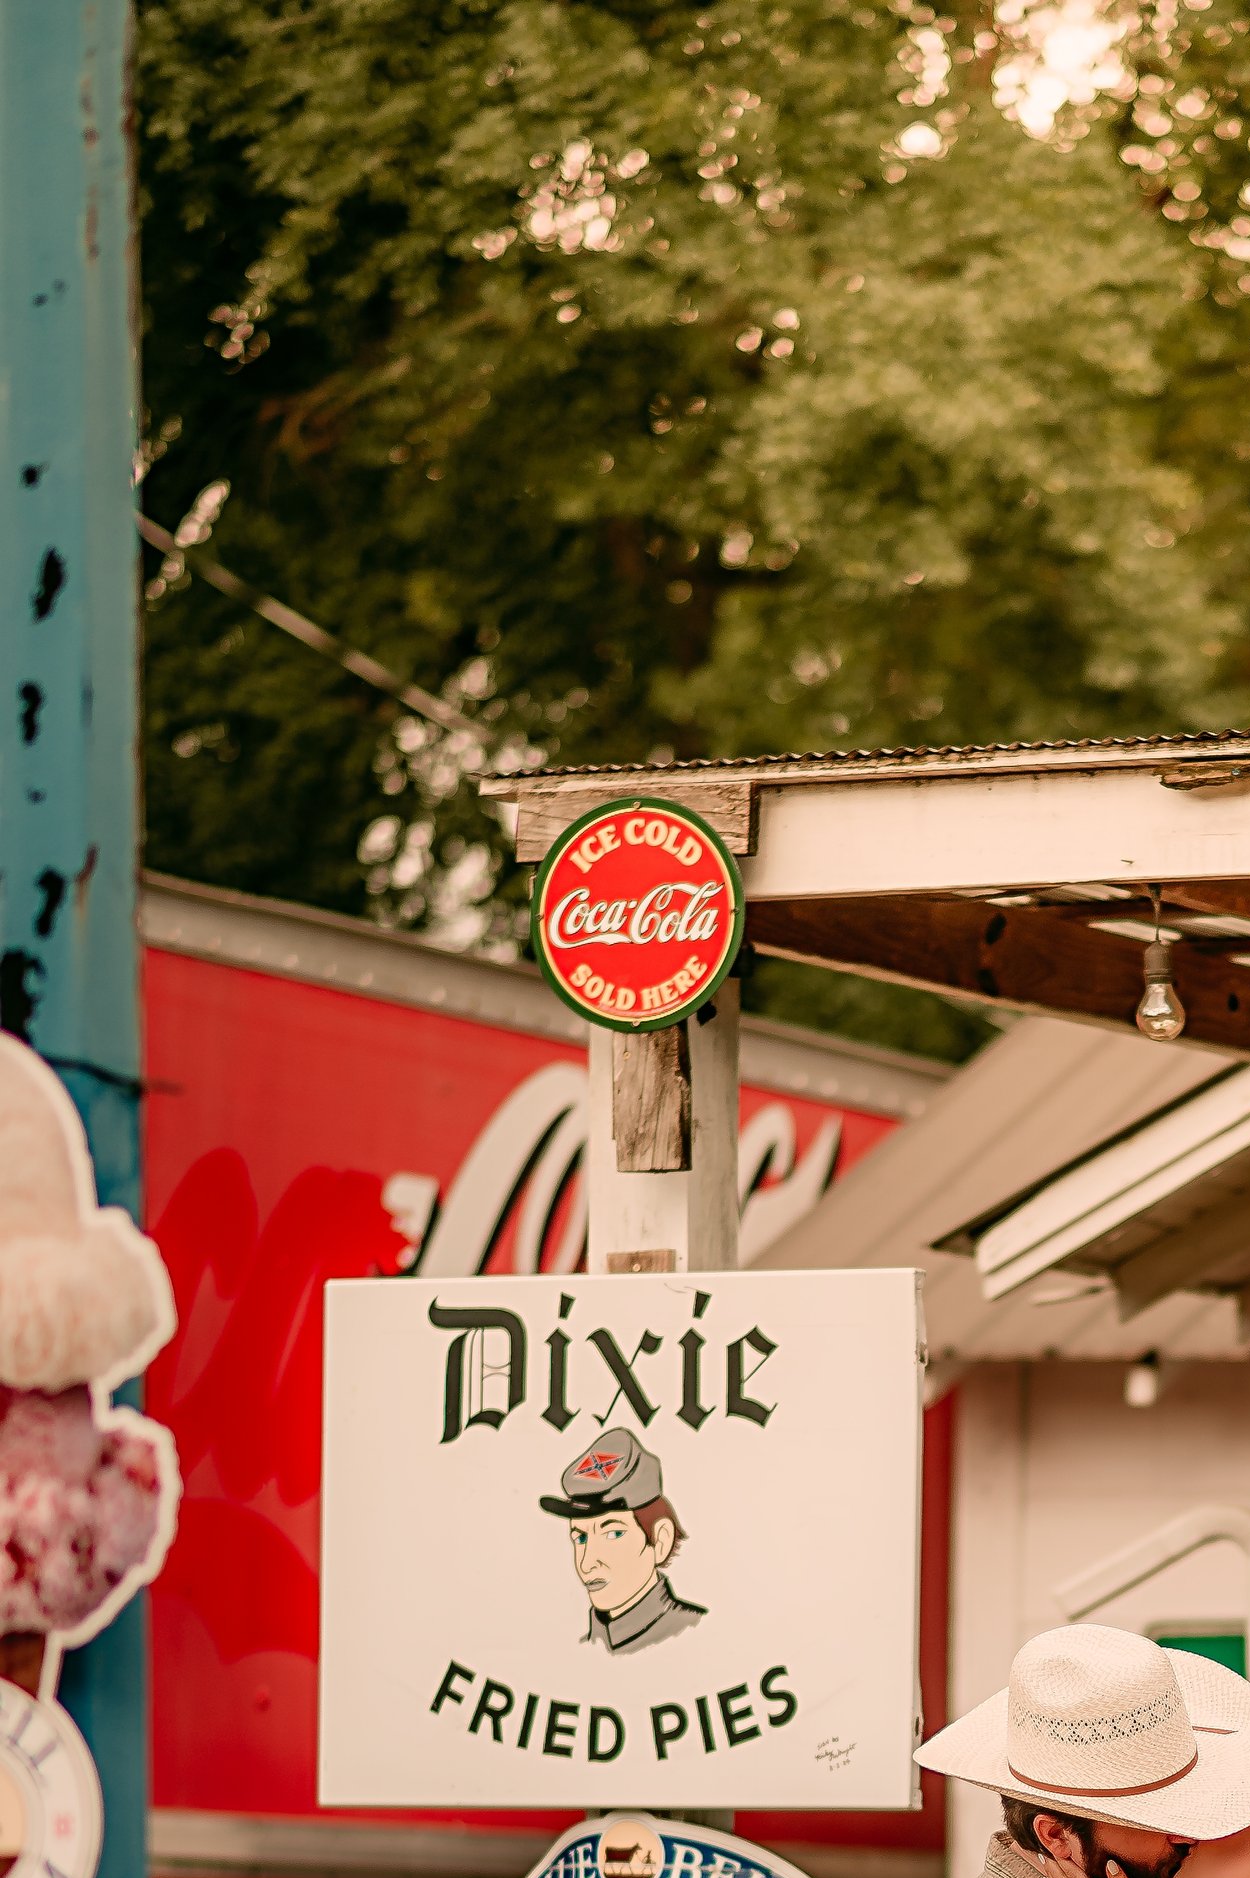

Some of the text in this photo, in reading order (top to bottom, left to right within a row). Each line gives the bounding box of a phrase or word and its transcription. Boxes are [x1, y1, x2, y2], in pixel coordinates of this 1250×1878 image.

[569, 817, 703, 874] ICE COLD
[548, 880, 725, 949] Coca-Cola
[570, 955, 708, 1011] SOLD HERE
[428, 1292, 780, 1444] Dixie
[430, 1659, 799, 1763] FRIED PIES
